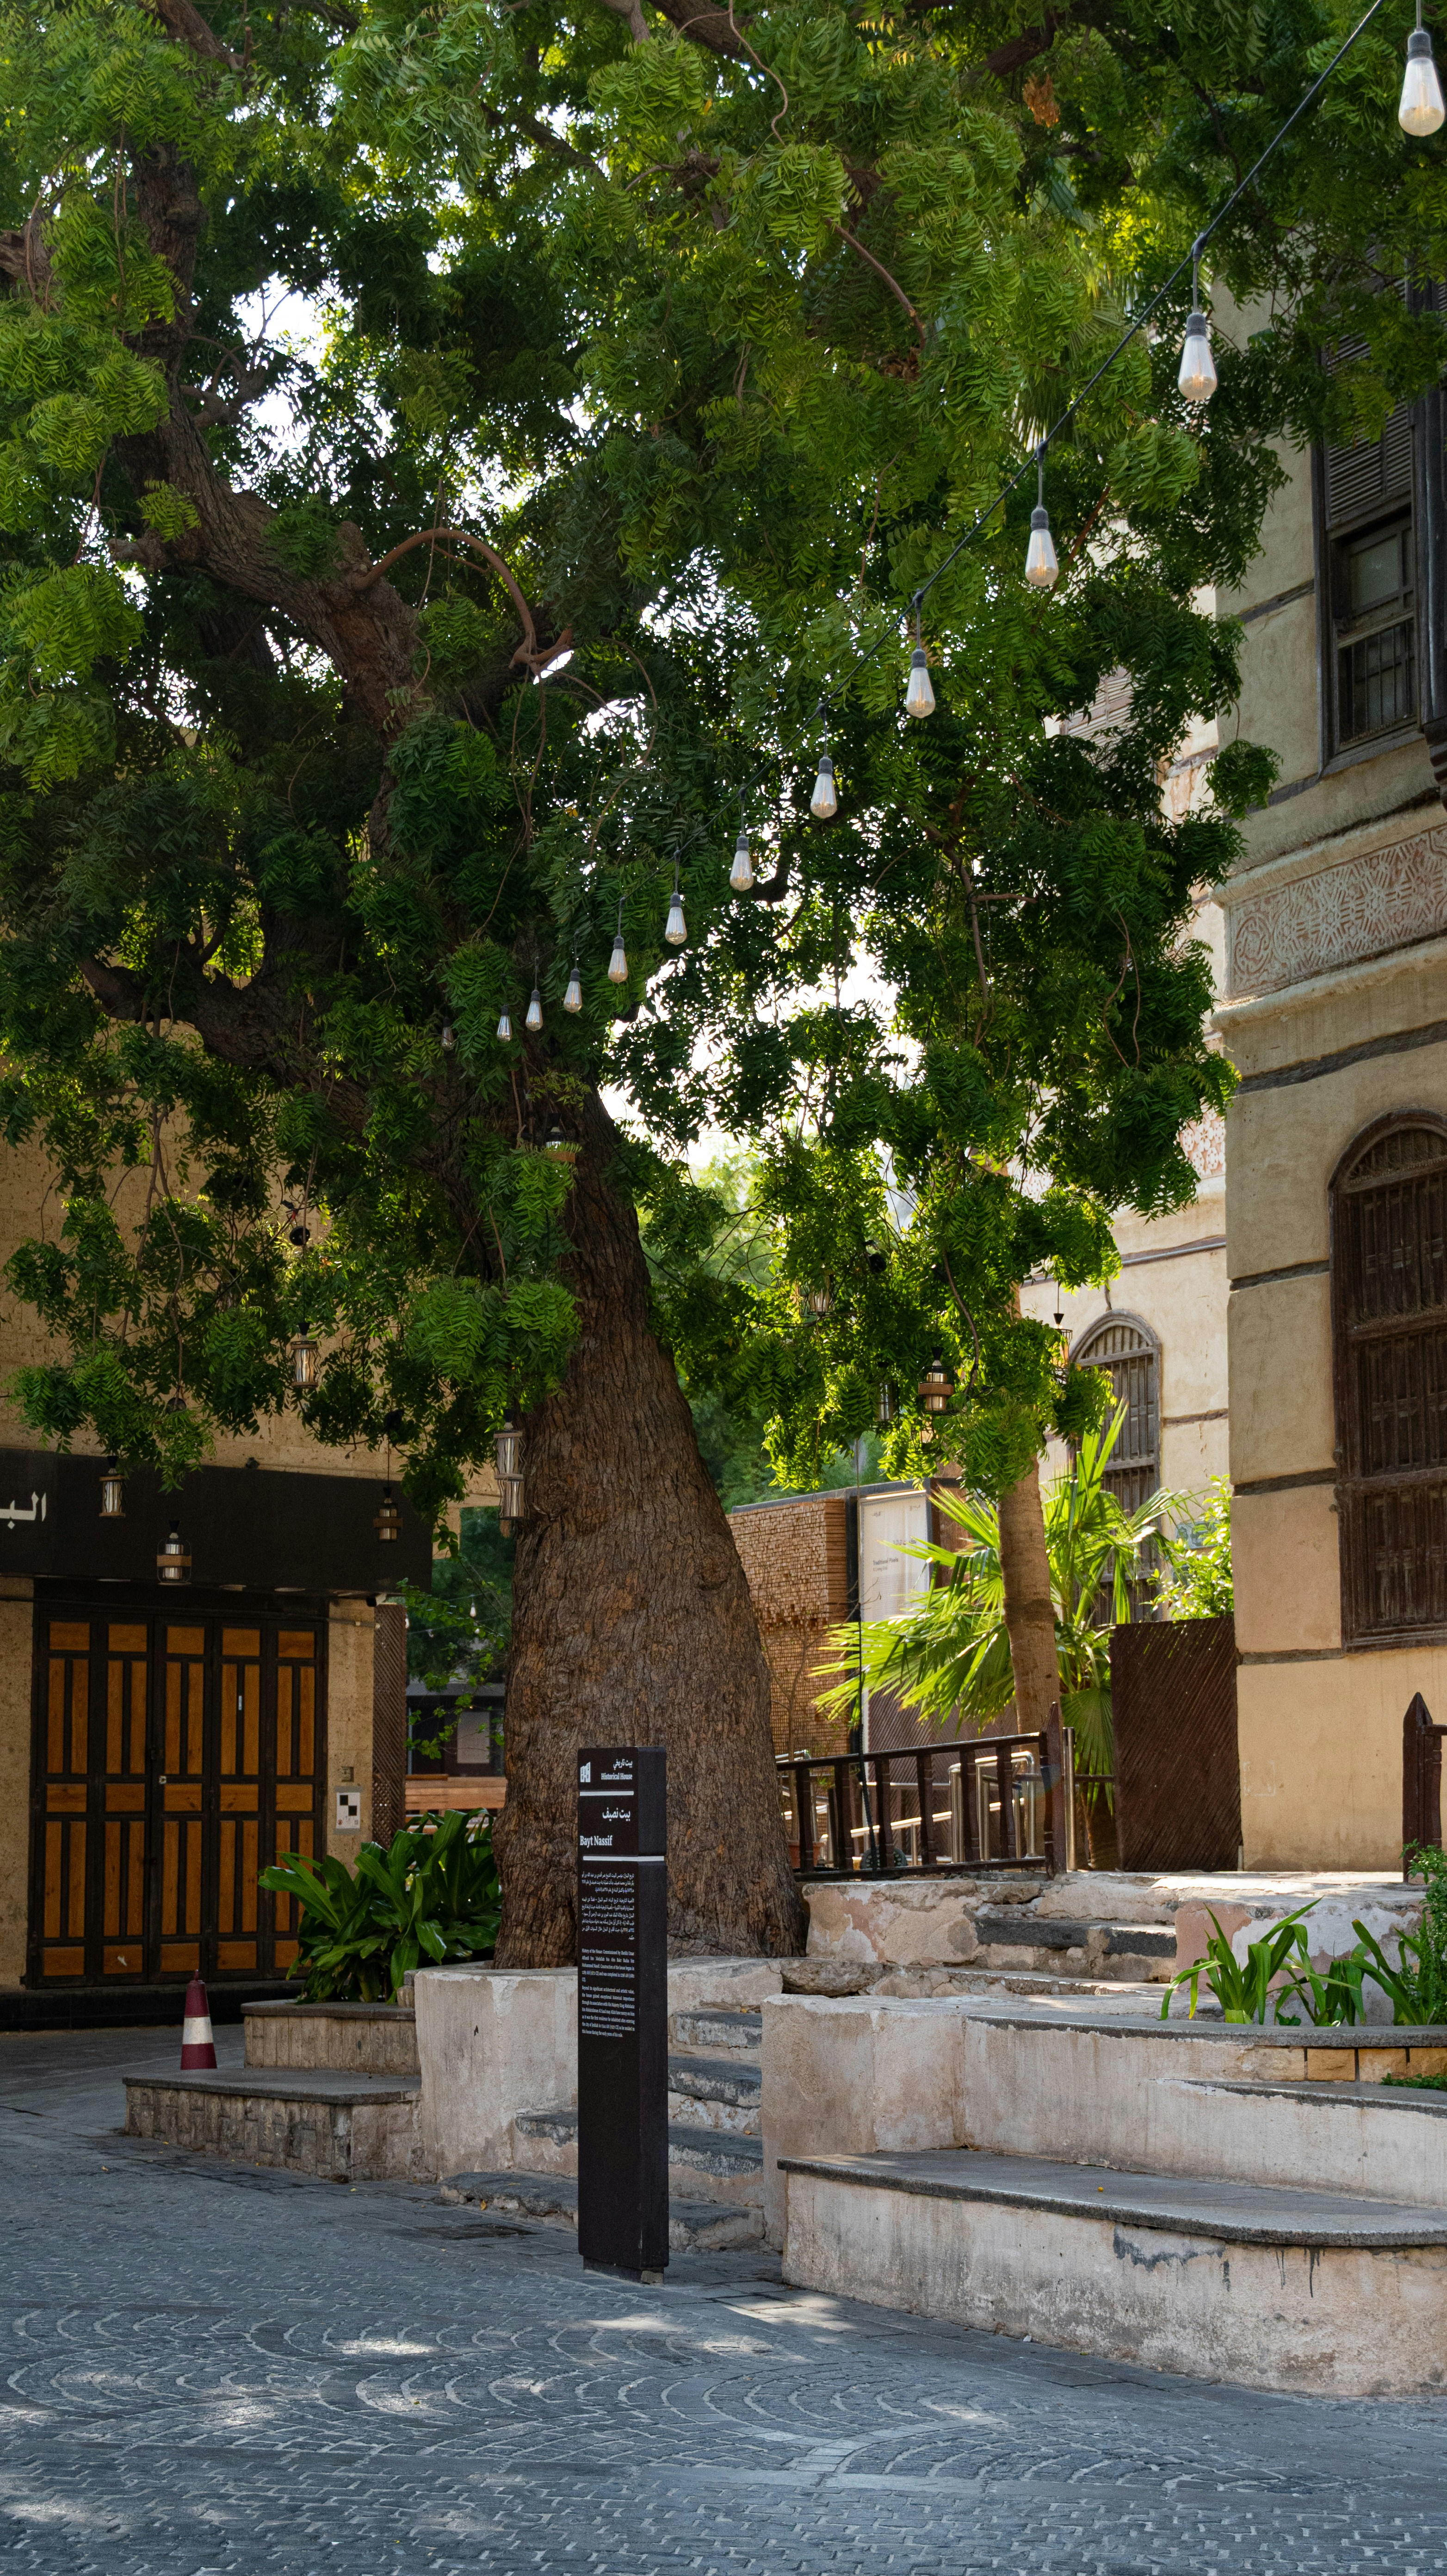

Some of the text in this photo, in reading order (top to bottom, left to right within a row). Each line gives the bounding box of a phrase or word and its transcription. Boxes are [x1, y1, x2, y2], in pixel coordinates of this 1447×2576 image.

[0, 1491, 46, 1530] الب
[613, 1759, 625, 1771] تاريخي
[602, 1807, 631, 1822] بيت نصيف
[580, 1835, 612, 1848] Bayt Nassif
